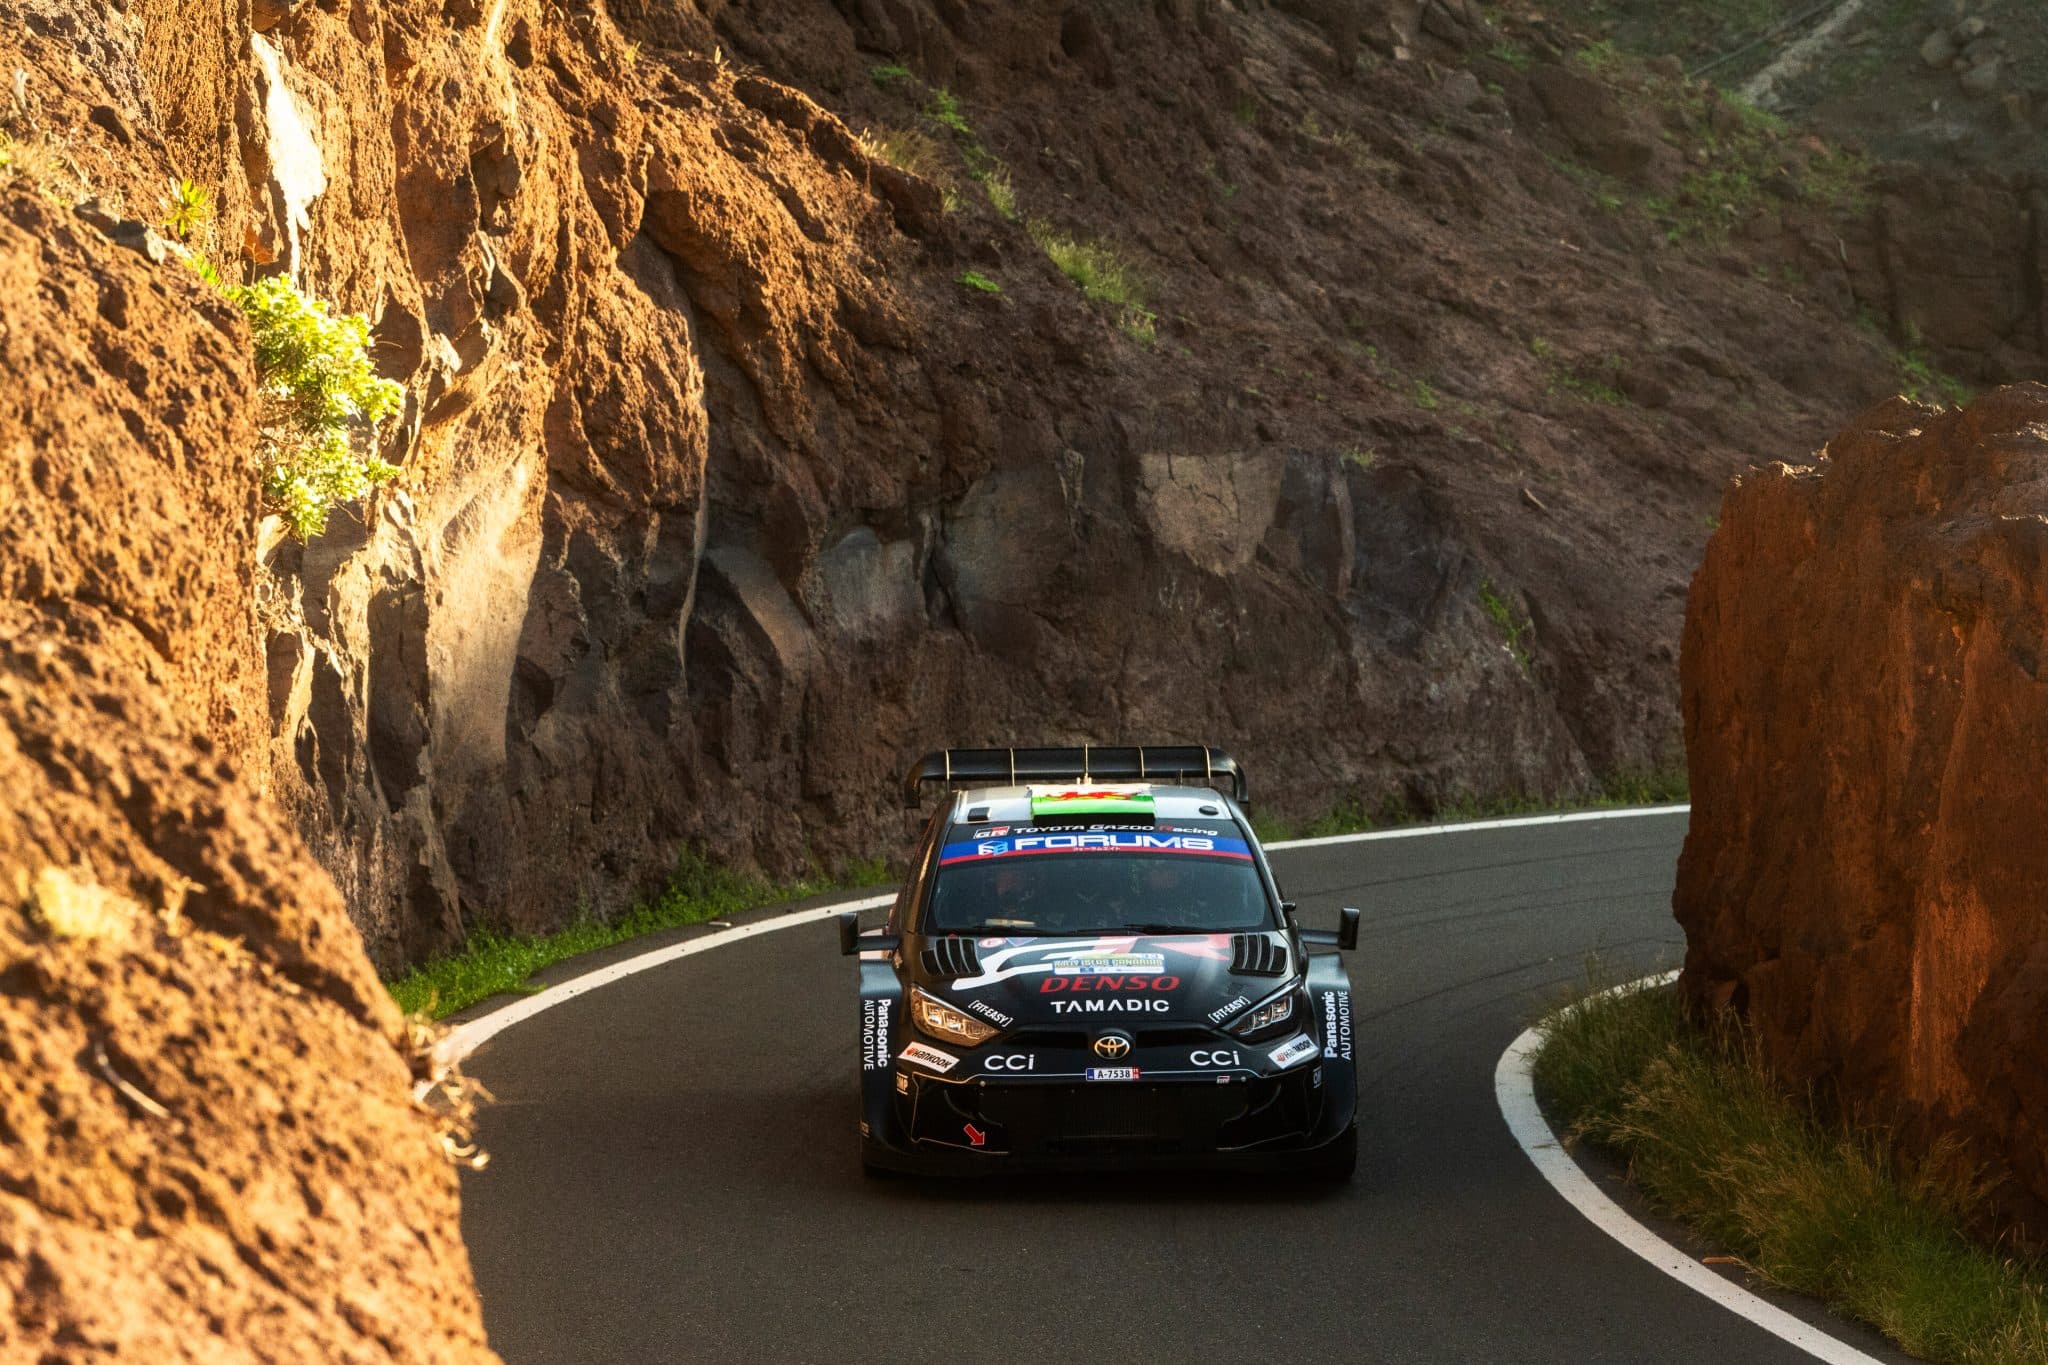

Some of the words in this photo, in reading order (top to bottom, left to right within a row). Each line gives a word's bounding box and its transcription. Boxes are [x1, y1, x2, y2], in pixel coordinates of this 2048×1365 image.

[1014, 825, 1085, 835] TOYOTA
[1087, 824, 1155, 832] GAZOO
[1158, 825, 1219, 836] Racing
[1015, 835, 1214, 851] FORUM8
[1040, 976, 1181, 993] DENSO
[1050, 999, 1170, 1013] TAMADIC
[877, 999, 892, 1068] Panasonic
[1322, 991, 1338, 1059] Panasonic
[1337, 991, 1352, 1061] AUTOMOTIVE
[863, 1000, 875, 1071] AUTOMOTIVE
[984, 1054, 1035, 1071] CCi
[1190, 1050, 1241, 1066] CCi
[1097, 1070, 1131, 1079] A-7538
